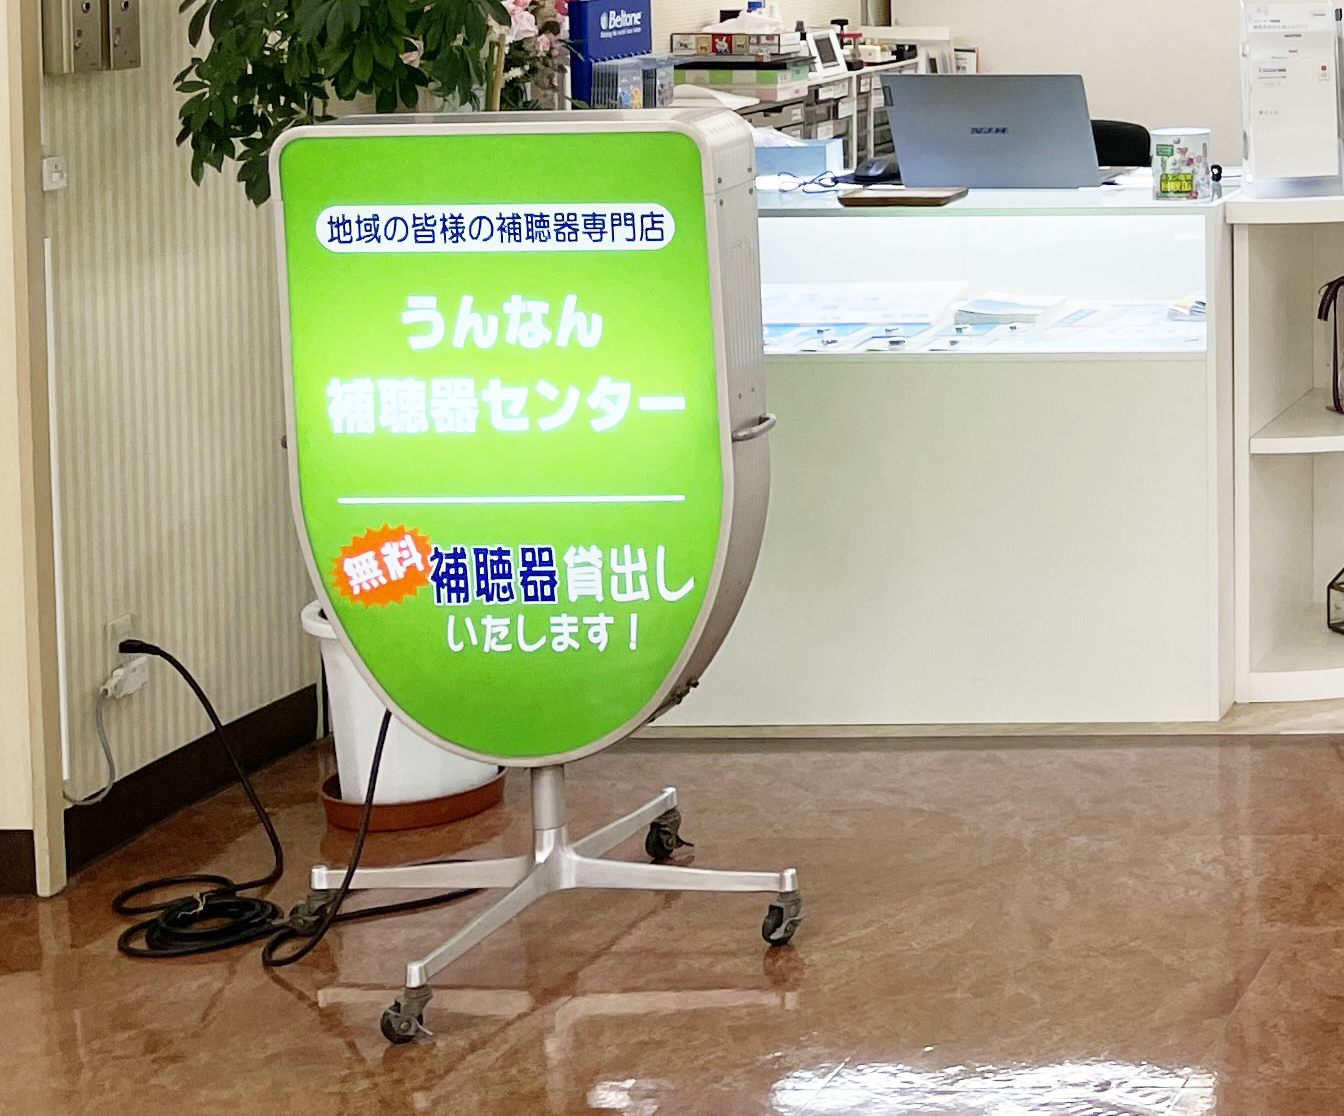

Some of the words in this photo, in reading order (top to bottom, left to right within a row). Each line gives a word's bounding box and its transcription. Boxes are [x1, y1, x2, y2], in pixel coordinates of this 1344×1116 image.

[608, 9, 642, 30] Beltone
[326, 210, 666, 247] 地域の皆様の補聴器専門店
[399, 293, 604, 351] うんなん
[326, 377, 687, 435] 補聴器センター
[342, 534, 424, 593] 無料
[429, 543, 696, 606] 補聴器貸出し
[446, 612, 639, 654] いたします!
